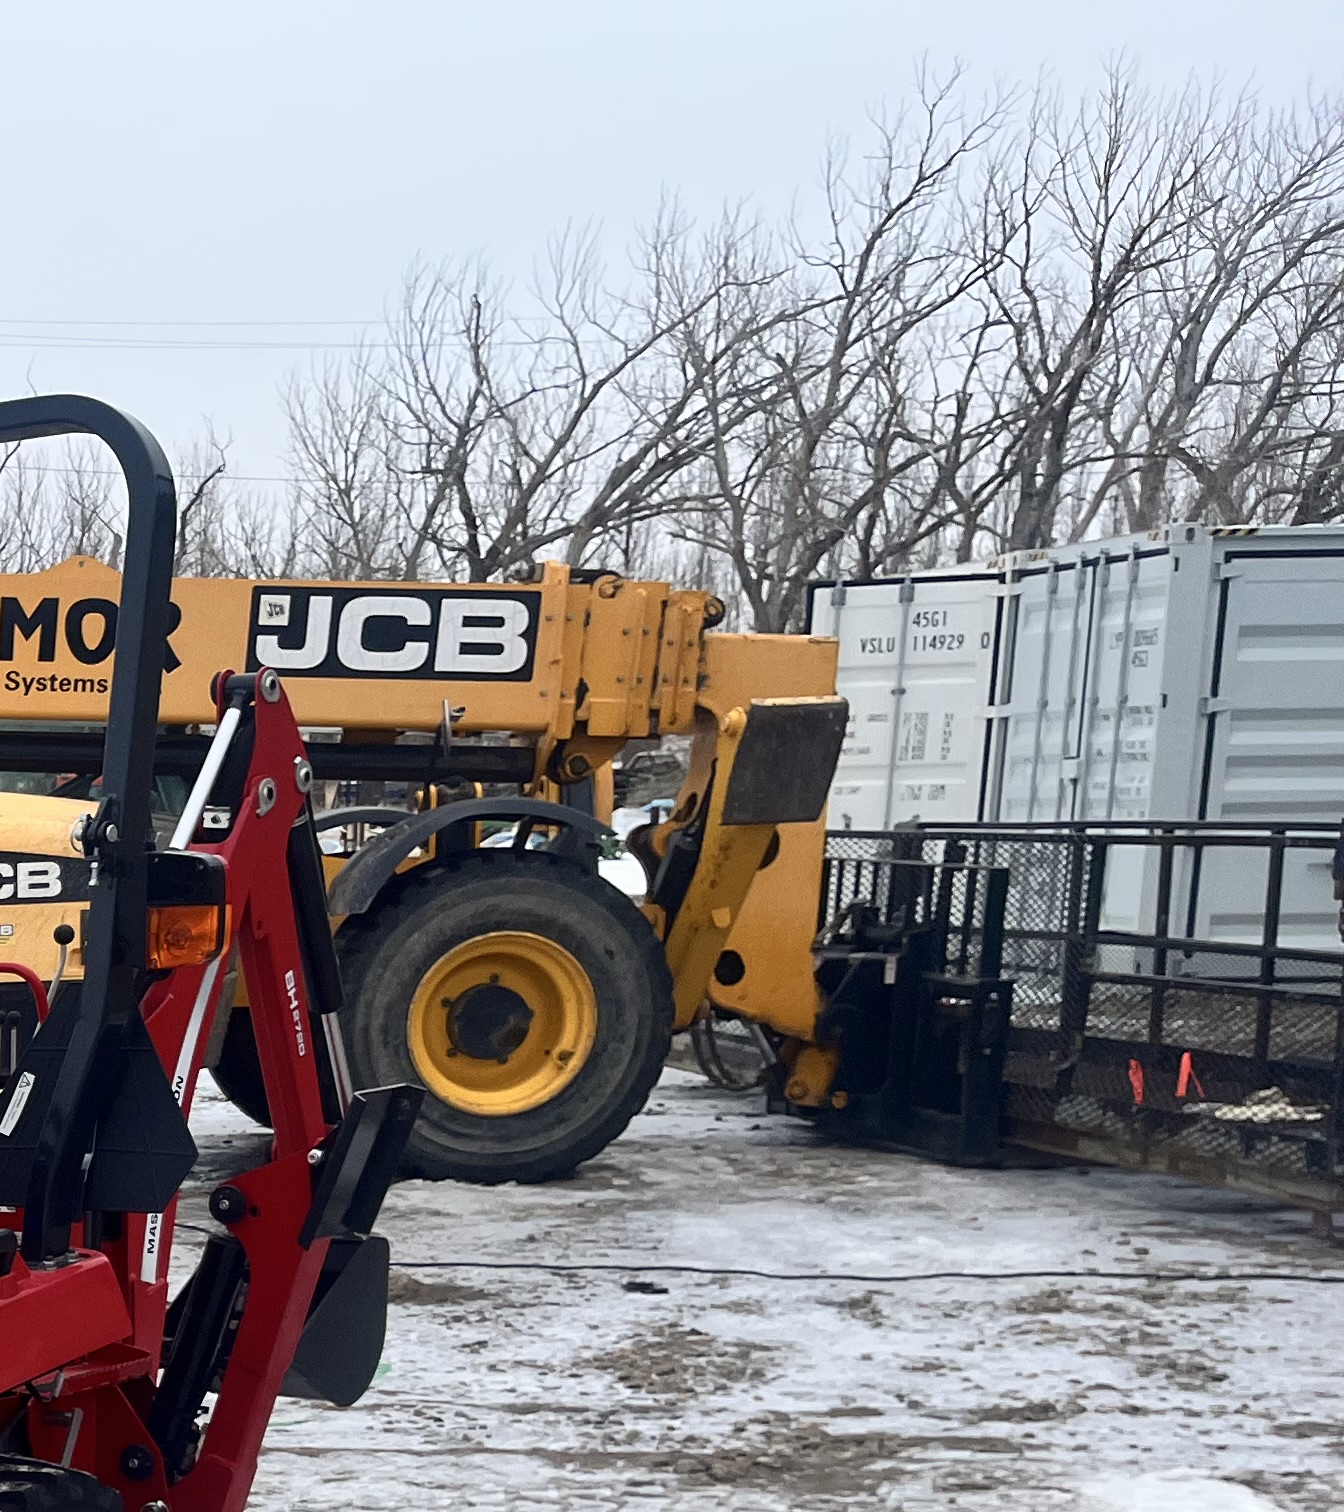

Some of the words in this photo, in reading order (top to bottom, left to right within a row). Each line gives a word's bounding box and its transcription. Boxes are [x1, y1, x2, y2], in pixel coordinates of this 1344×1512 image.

[912, 610, 948, 628] 45G1
[256, 596, 529, 672] JCB
[861, 636, 895, 653] VSLU
[913, 634, 964, 651] 114929
[4, 671, 108, 695] Systems
